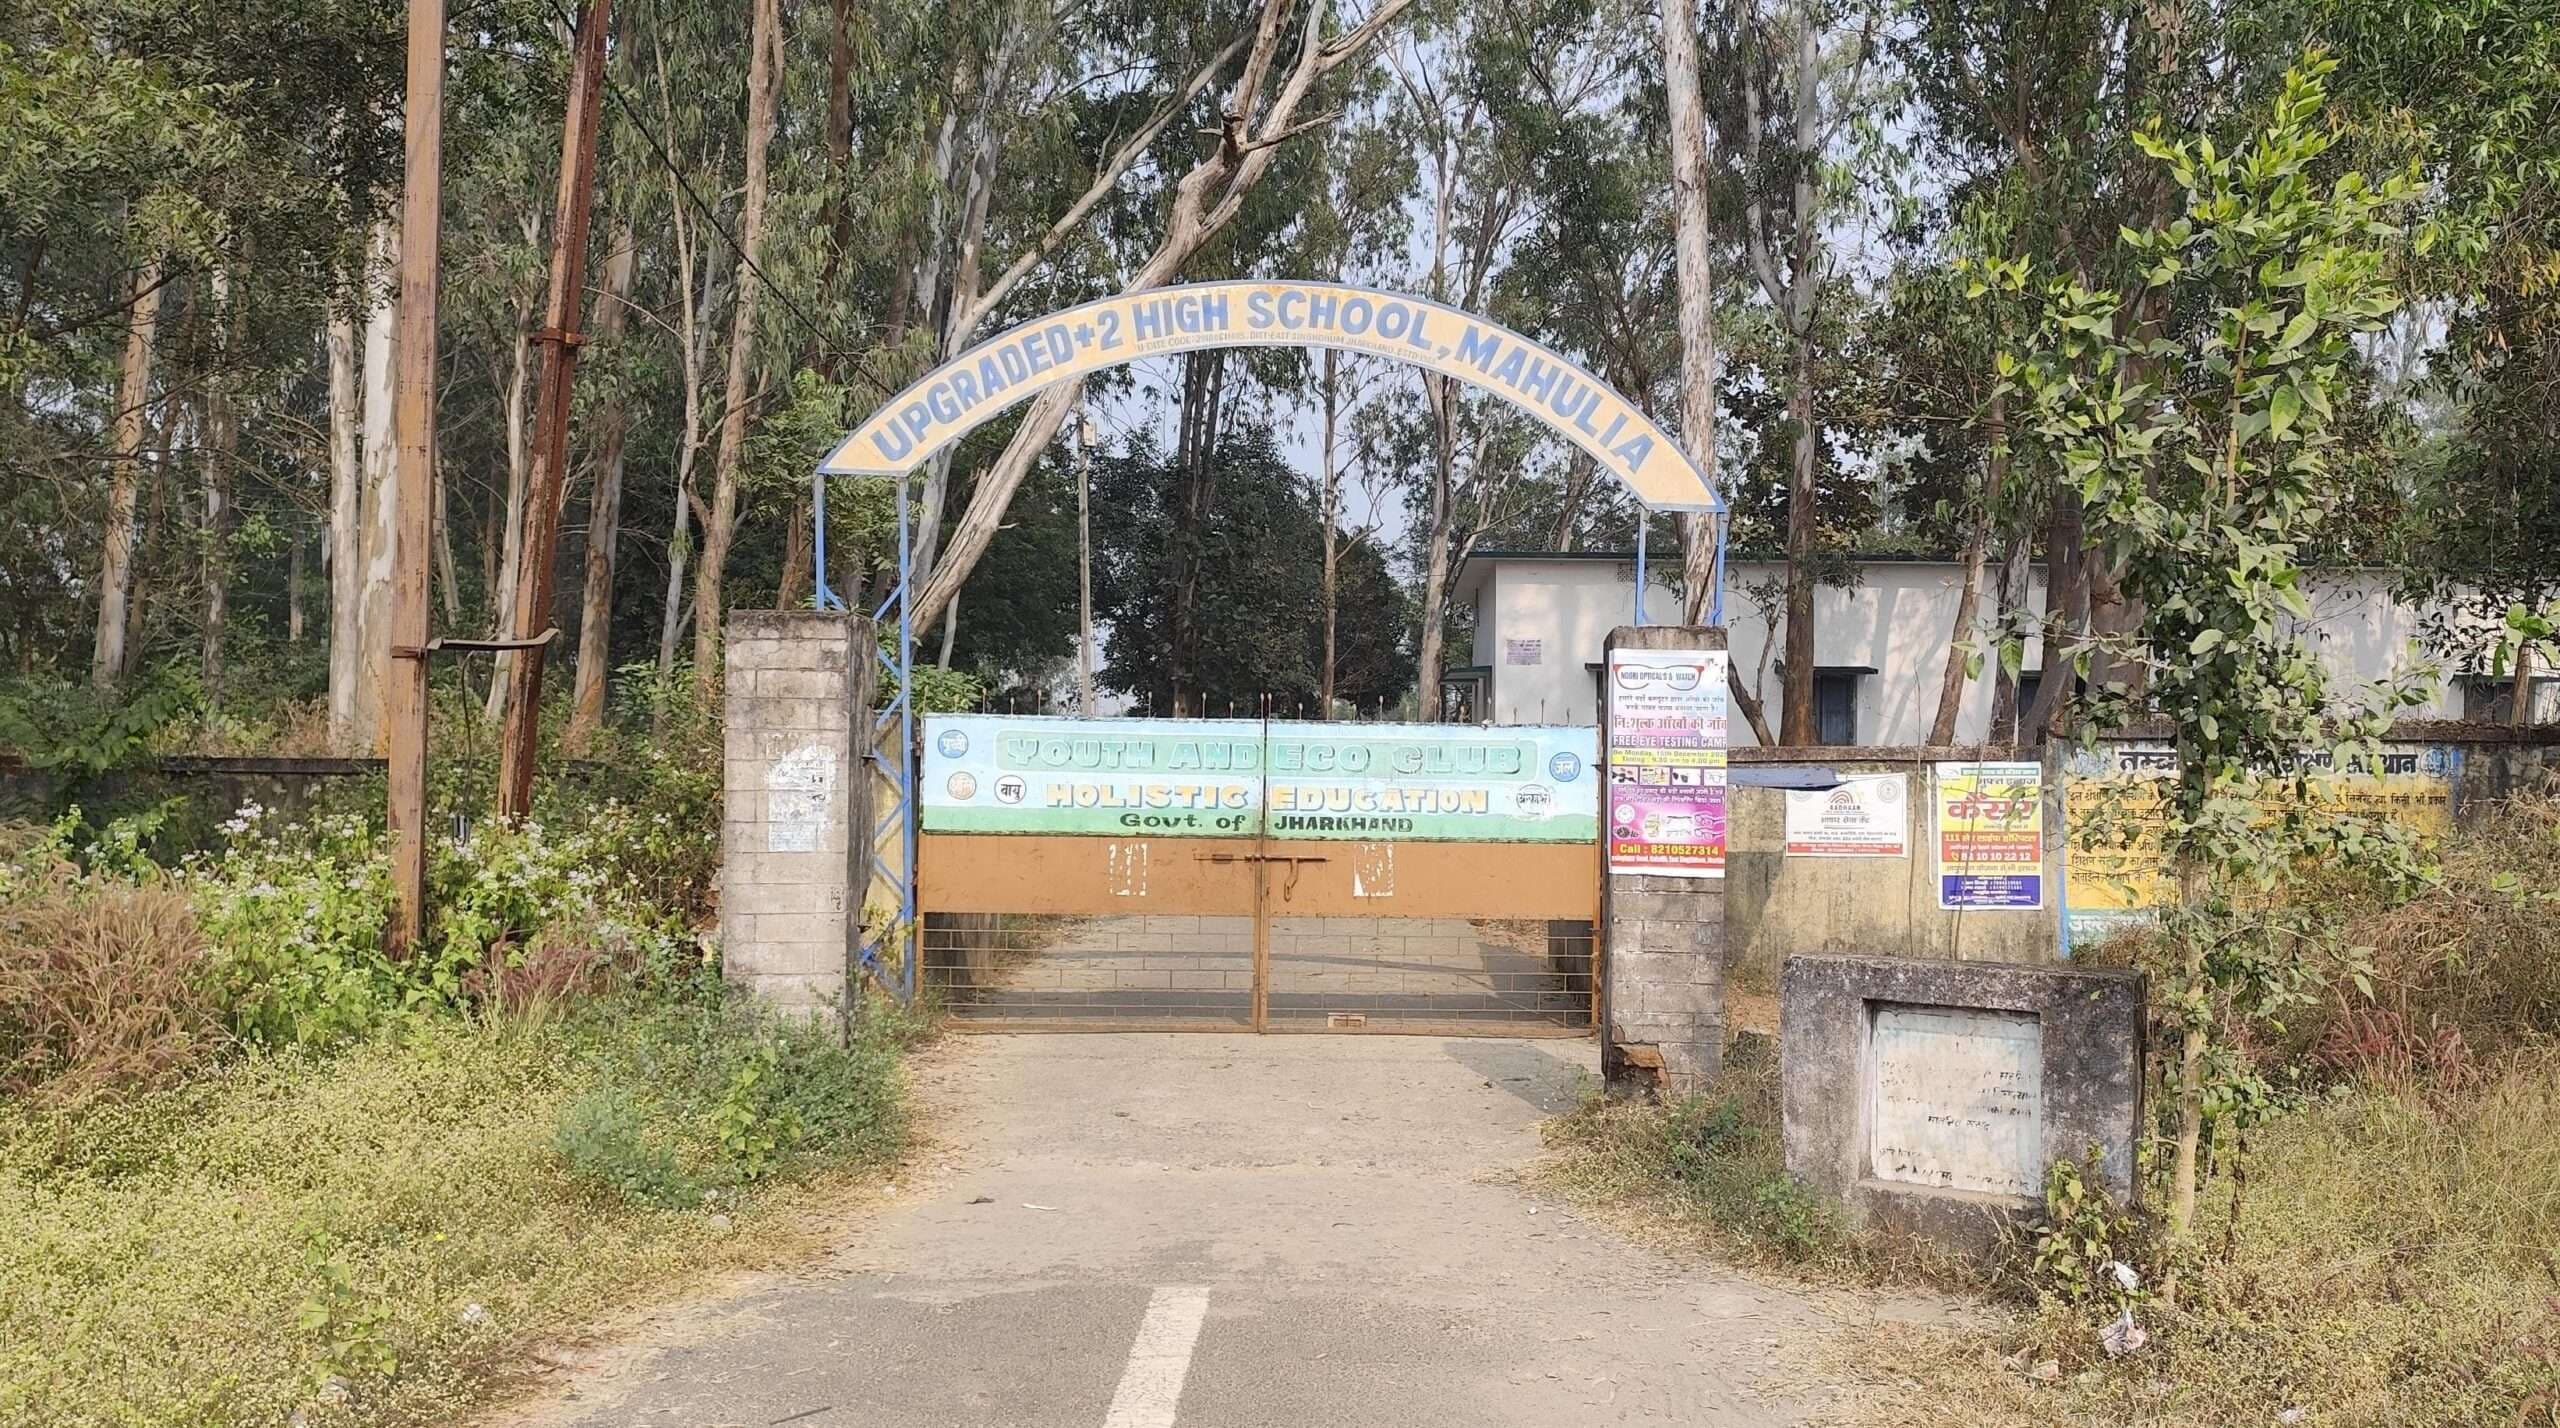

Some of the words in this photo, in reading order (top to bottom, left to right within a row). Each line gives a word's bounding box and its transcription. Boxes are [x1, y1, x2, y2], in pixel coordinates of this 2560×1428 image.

[870, 309, 1124, 462] UPGRADED+2
[1131, 292, 1230, 341] HIGH
[1455, 324, 1655, 475] MAHULIA
[1613, 735, 1637, 747] FREE
[1639, 735, 1657, 747] EYE
[1659, 736, 1698, 748] TESTING
[1008, 738, 1156, 768] YOUTH
[1168, 741, 1259, 771] AND
[1273, 743, 1371, 773] ECO
[1391, 744, 1522, 774] CLUB
[1000, 783, 1022, 800] वायु
[1046, 783, 1248, 809] HOLISTIC
[1271, 785, 1489, 814] EDUCATION
[1119, 812, 1203, 828] Govt.
[1215, 813, 1246, 832] of
[1274, 814, 1413, 833] JHARKHAND
[1619, 843, 1641, 854] Call
